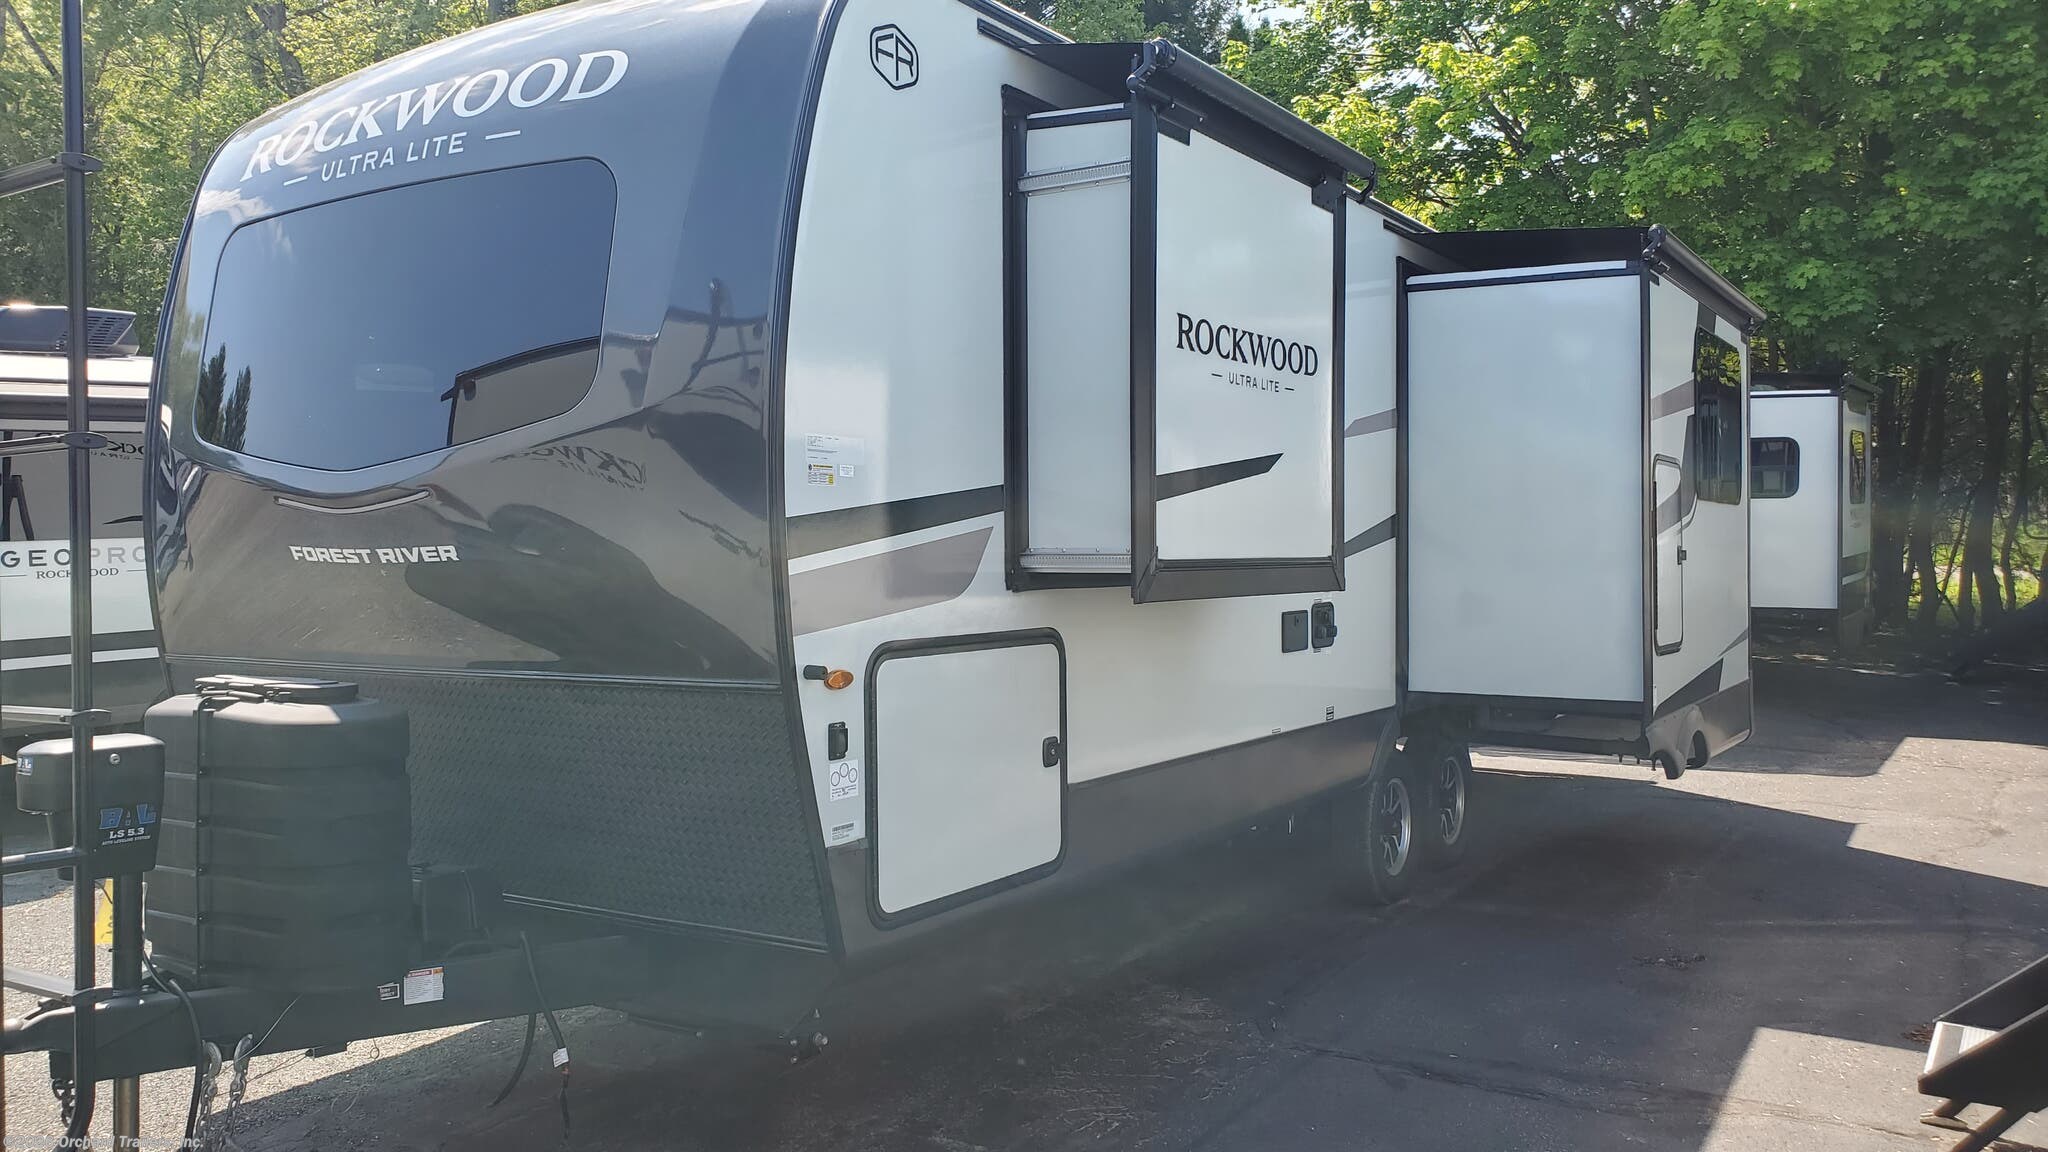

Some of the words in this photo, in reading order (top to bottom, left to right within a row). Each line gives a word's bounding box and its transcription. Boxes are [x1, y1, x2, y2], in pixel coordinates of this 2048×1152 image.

[240, 49, 629, 182] ROCKWOOD
[321, 146, 396, 183] ULTRA
[406, 131, 468, 163] LITE
[1176, 312, 1319, 377] ROCKWOOD
[1228, 371, 1258, 389] ULTRA
[1261, 378, 1280, 393] LITE
[289, 545, 371, 564] FOREST
[375, 545, 460, 564] RIVER
[36, 567, 119, 579] ROCOOD
[109, 830, 125, 839] LS
[127, 827, 145, 836] 5.3
